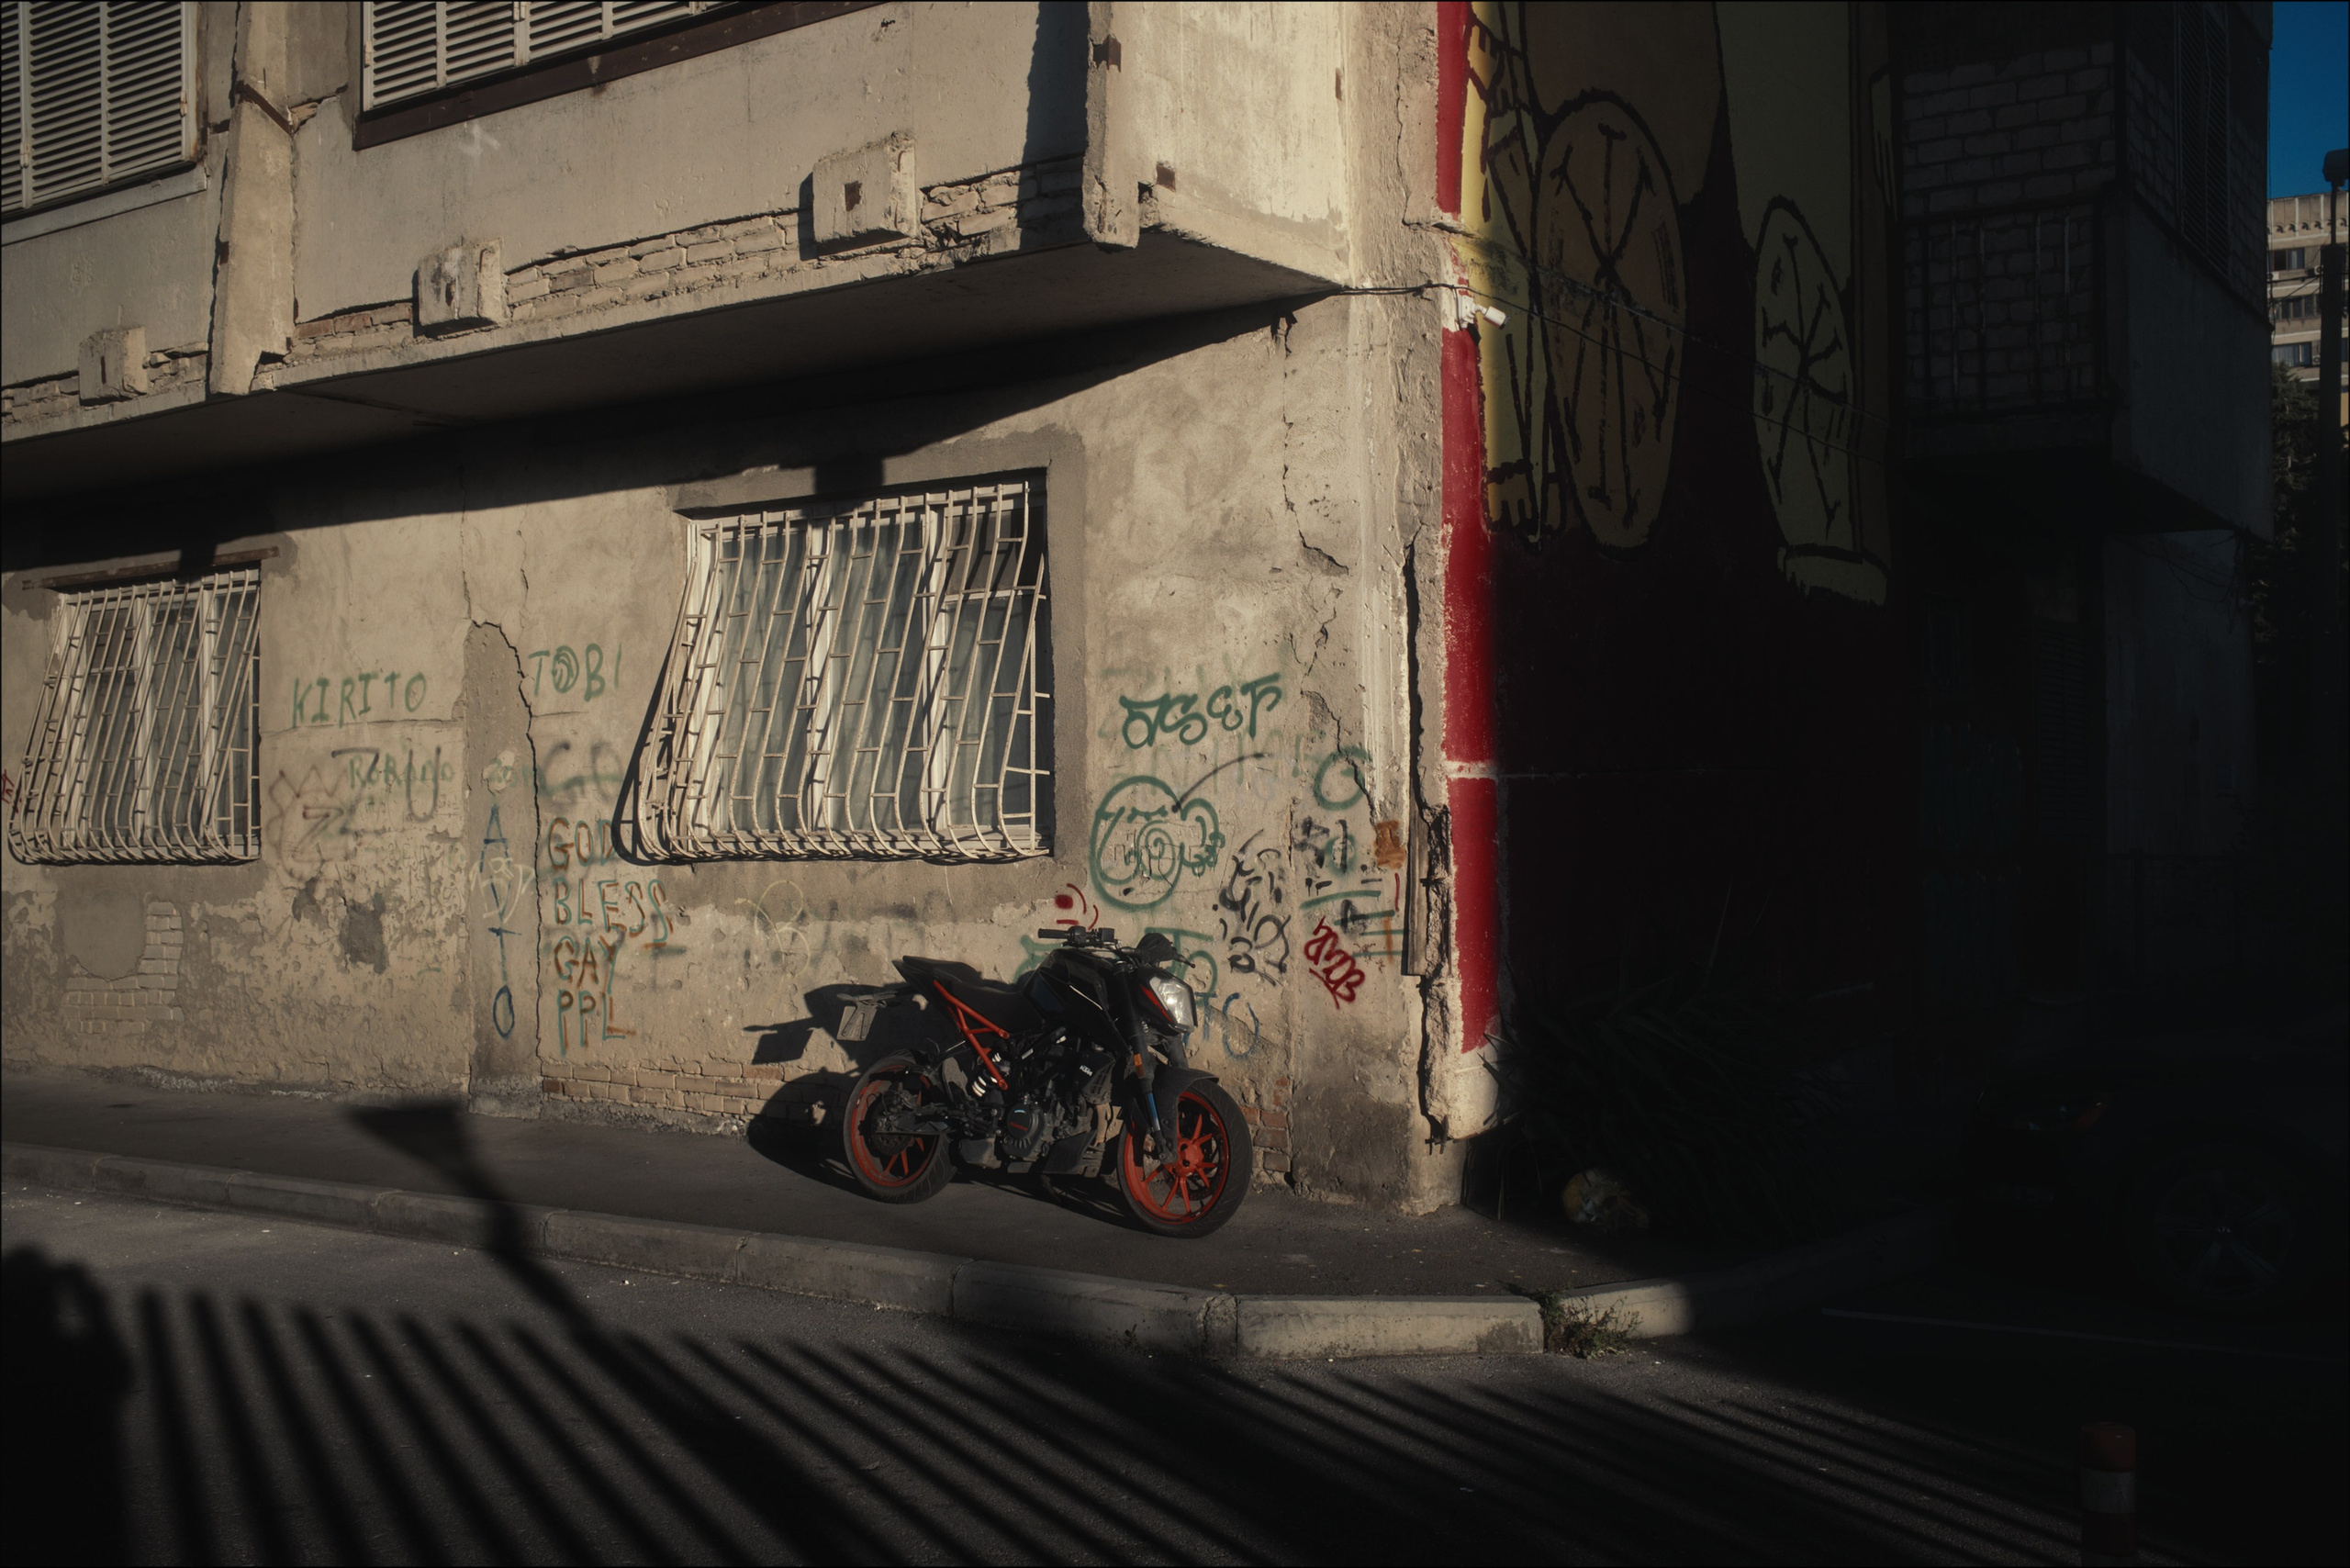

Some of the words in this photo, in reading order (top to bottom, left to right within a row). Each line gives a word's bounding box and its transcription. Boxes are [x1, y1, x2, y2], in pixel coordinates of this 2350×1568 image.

[292, 672, 427, 727] KIRITO
[548, 816, 617, 871] GOD
[553, 877, 675, 948] BLESS
[553, 935, 621, 995] GAY
[557, 989, 636, 1057] PPL
